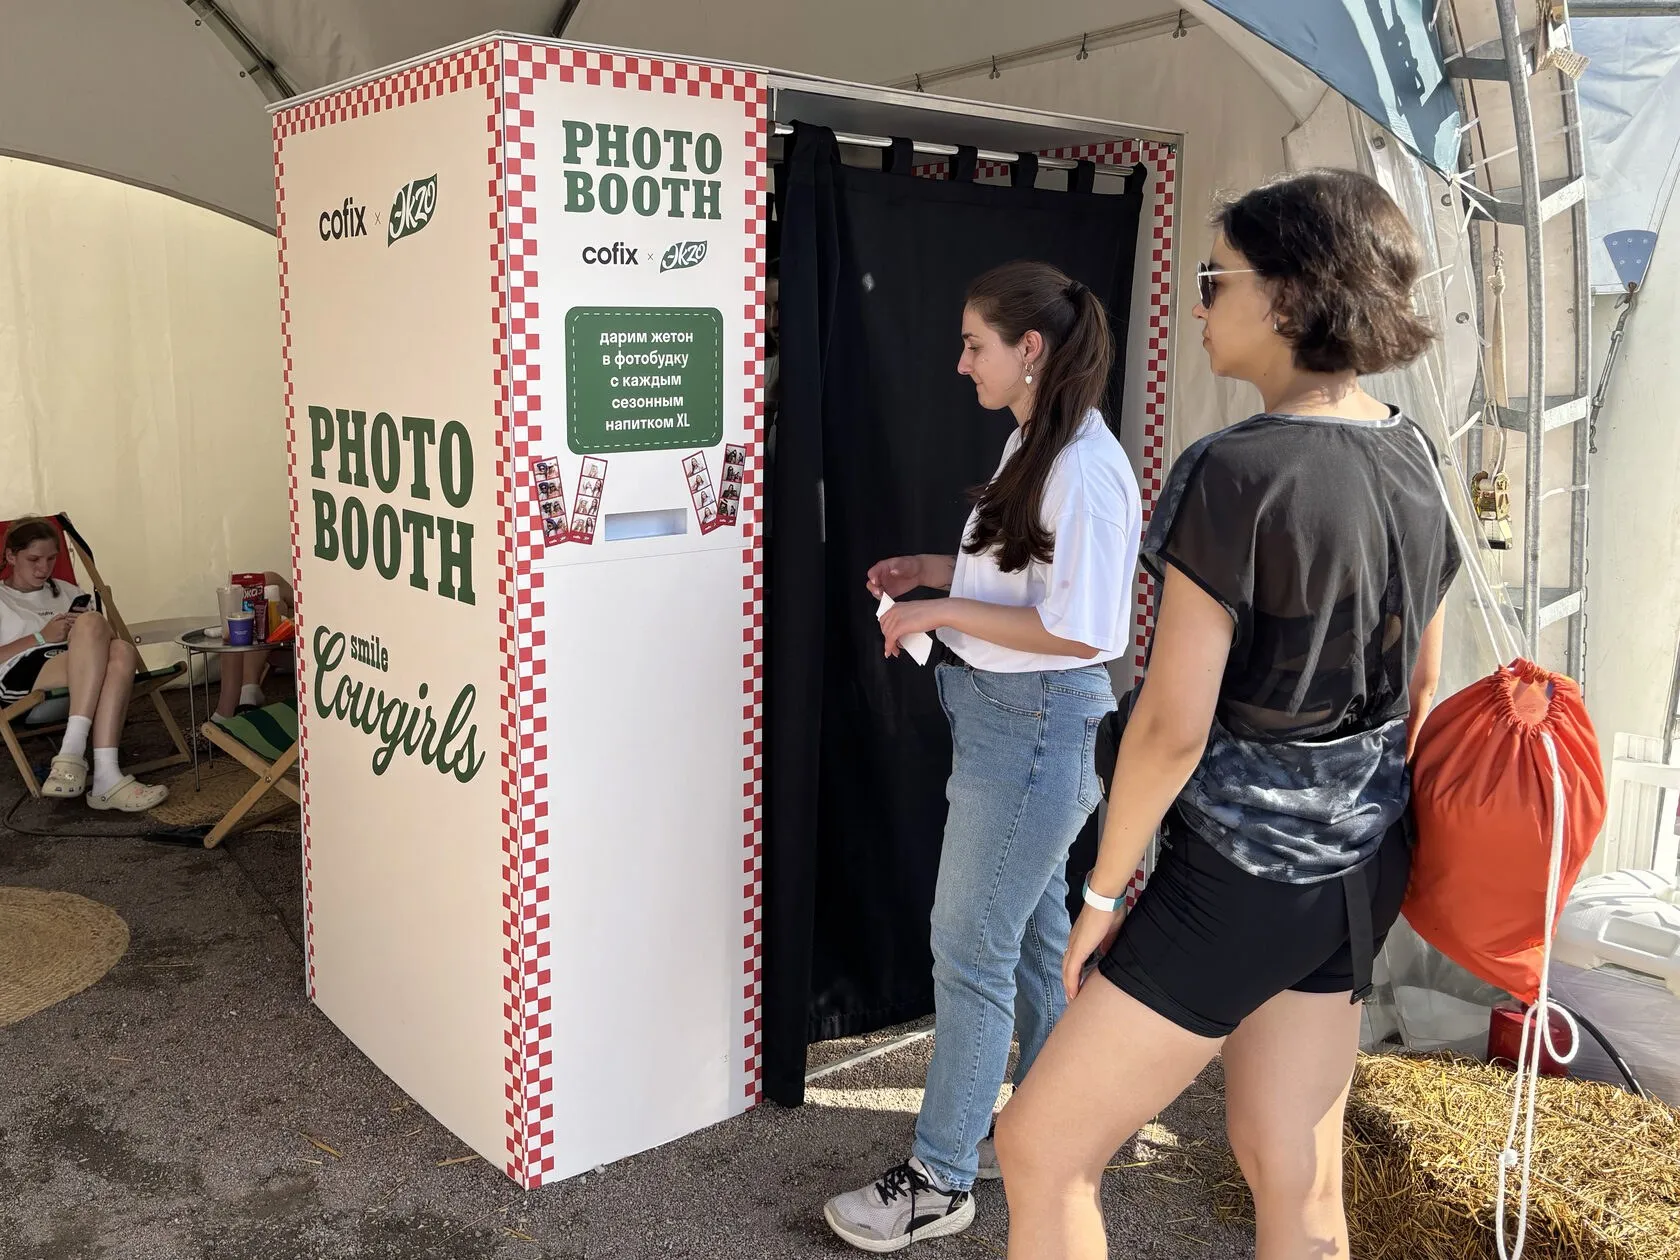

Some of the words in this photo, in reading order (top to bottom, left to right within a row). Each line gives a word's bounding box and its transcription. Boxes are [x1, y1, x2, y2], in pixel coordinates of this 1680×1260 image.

[562, 120, 722, 174] PHOTO
[563, 170, 722, 220] BOOTH
[319, 197, 367, 241] cofix
[582, 242, 639, 265] cofix
[599, 332, 648, 347] дарим
[650, 332, 694, 343] жетон
[602, 354, 611, 365] в
[614, 350, 689, 370] фотобудку
[610, 376, 619, 388] с
[622, 375, 682, 389] каждым
[611, 396, 684, 409] сезонным
[605, 418, 674, 431] напитком
[676, 413, 691, 428] XL
[308, 405, 475, 508] PHOTO
[312, 488, 476, 606] BOOTH
[350, 635, 389, 673] smile
[313, 625, 486, 784] Cowgirls
